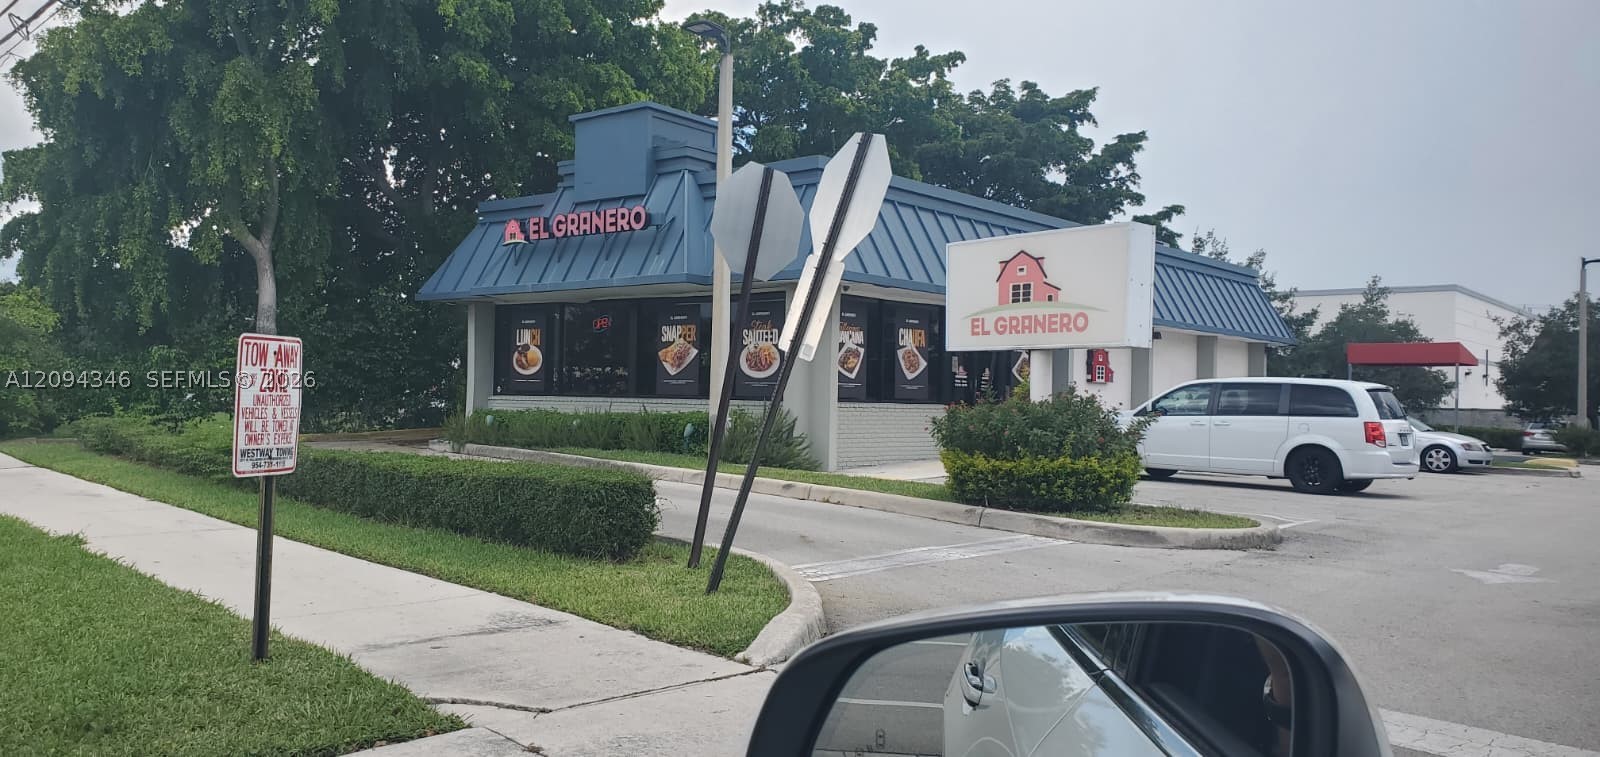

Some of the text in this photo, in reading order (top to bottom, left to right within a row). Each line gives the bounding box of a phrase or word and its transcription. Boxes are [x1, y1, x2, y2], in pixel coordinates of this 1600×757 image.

[529, 205, 646, 240] EL GRANERO
[970, 311, 1089, 336] EL GRANERO
[515, 329, 541, 345] LUNCH
[661, 325, 697, 342] SNAPPER
[898, 328, 925, 348] CHAUFA
[245, 341, 299, 369] TOW AWAY
[259, 368, 288, 393] ZONE
[253, 394, 291, 407] UNAUTHORIZED
[241, 407, 298, 420] VEHICLES & VESSELS
[244, 420, 257, 433] WILL
[261, 420, 269, 432] BE
[272, 420, 288, 432] TOWED
[244, 433, 270, 446] OWNER'S
[239, 447, 274, 459] WESTWAY
